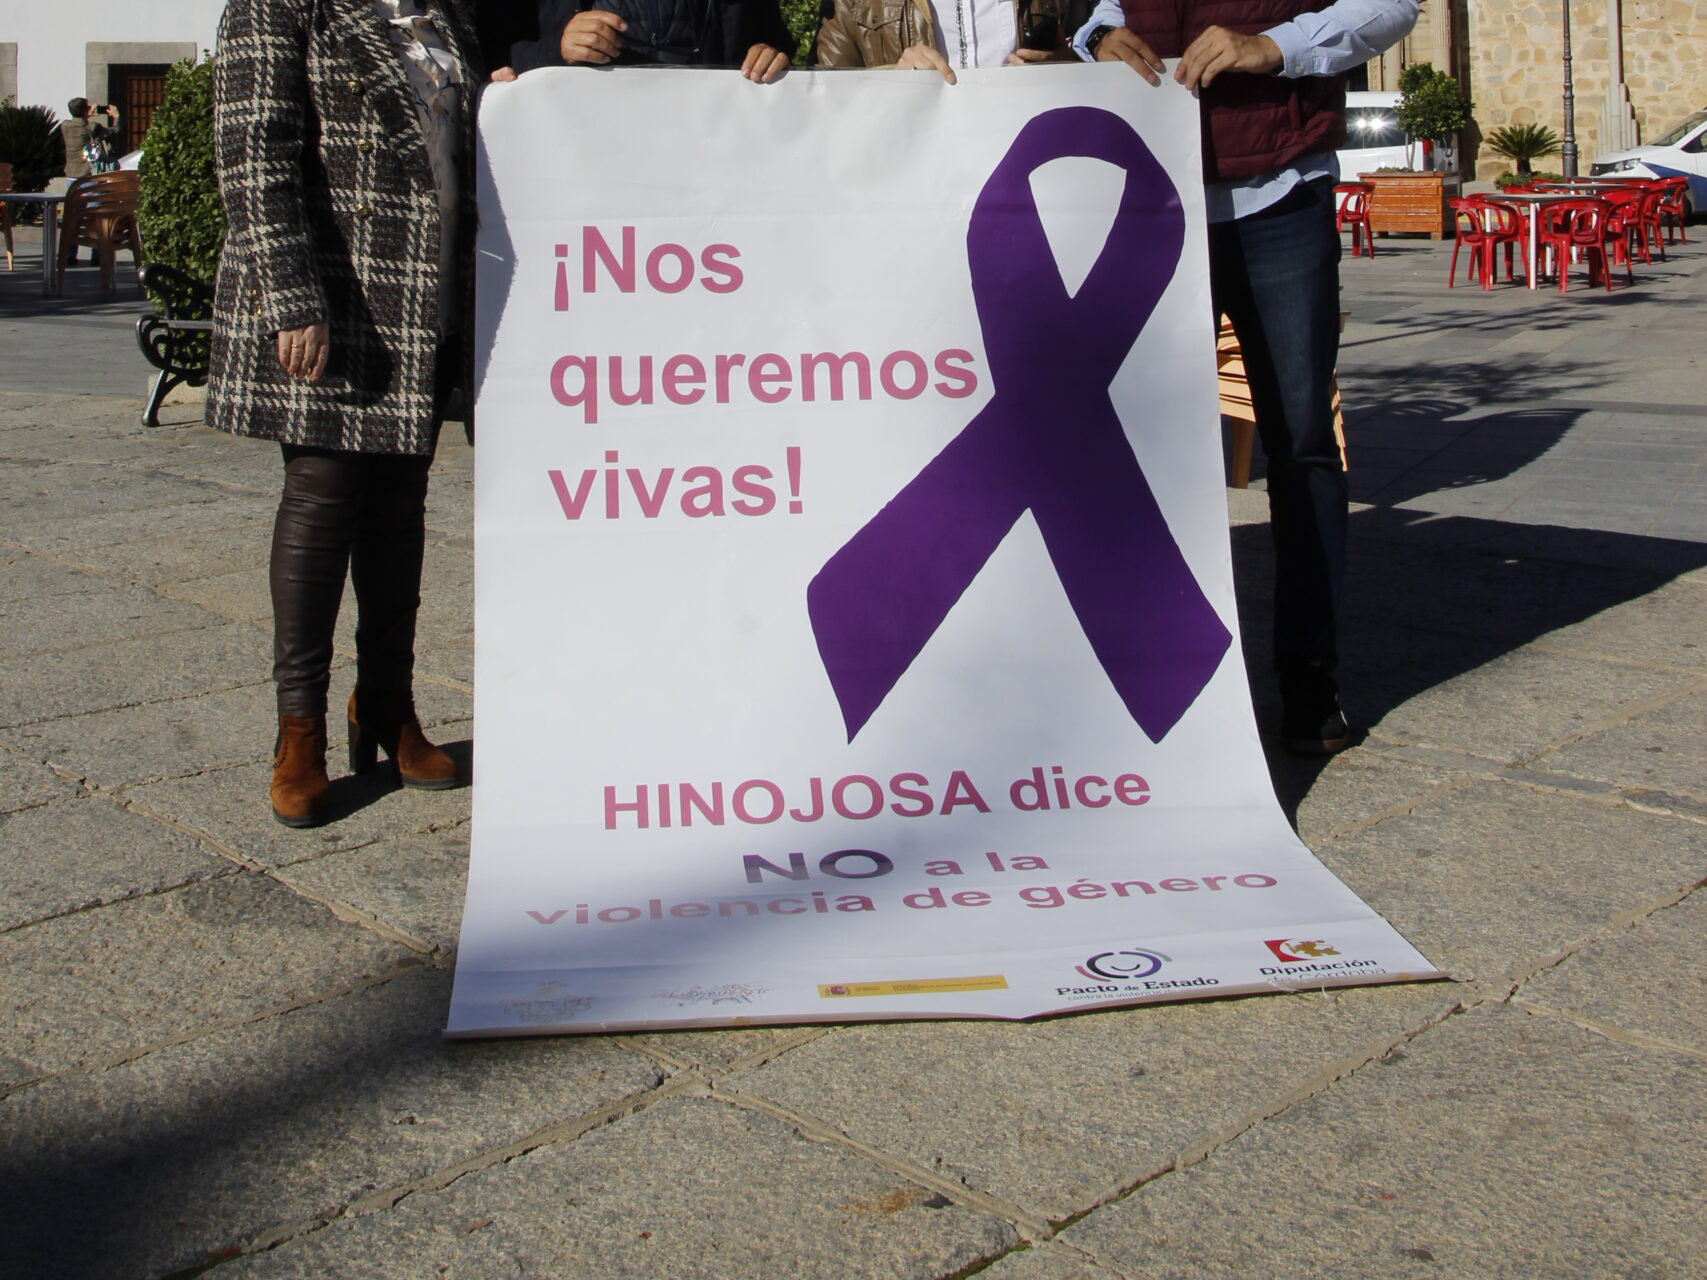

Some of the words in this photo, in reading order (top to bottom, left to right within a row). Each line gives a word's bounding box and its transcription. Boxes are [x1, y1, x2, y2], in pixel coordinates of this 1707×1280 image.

[553, 225, 744, 312] ¡Nos
[549, 348, 979, 424] queremos
[548, 445, 804, 520] vivas!
[603, 770, 991, 830] HINOJOSA
[1009, 766, 1151, 811] dice
[742, 849, 895, 884] NO
[924, 860, 964, 876] a
[984, 851, 1050, 872] la
[526, 891, 876, 925] violencia
[902, 887, 992, 910] de
[1018, 871, 1278, 909] género
[1056, 983, 1118, 996] Pacto
[1124, 984, 1140, 992] de
[1142, 976, 1220, 990] Estado
[1258, 958, 1378, 976] Diputación
